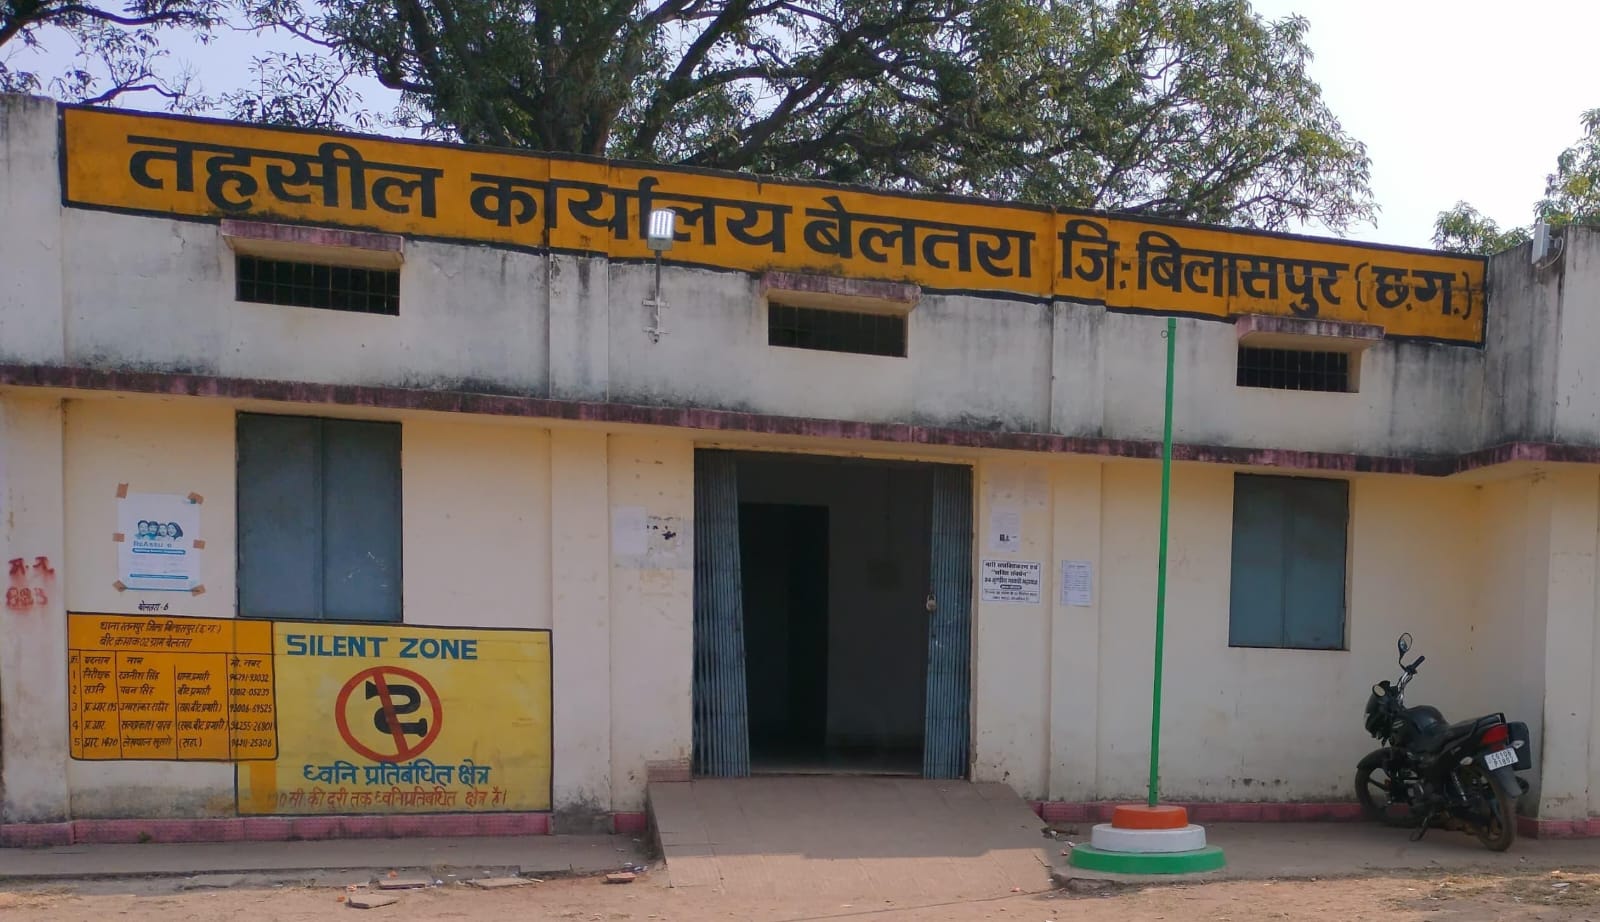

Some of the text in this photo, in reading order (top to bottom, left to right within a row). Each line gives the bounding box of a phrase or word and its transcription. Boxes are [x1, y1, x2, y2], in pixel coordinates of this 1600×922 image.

[127, 135, 443, 218] तहसील
[470, 173, 792, 253] कार्यालय
[803, 195, 1036, 278] बेलतरा
[1136, 230, 1350, 316] बिलासपुर
[287, 634, 478, 660] SILENT ZONE
[303, 759, 492, 787] ध्वनि प्रतिबंधित क्षेत्र
